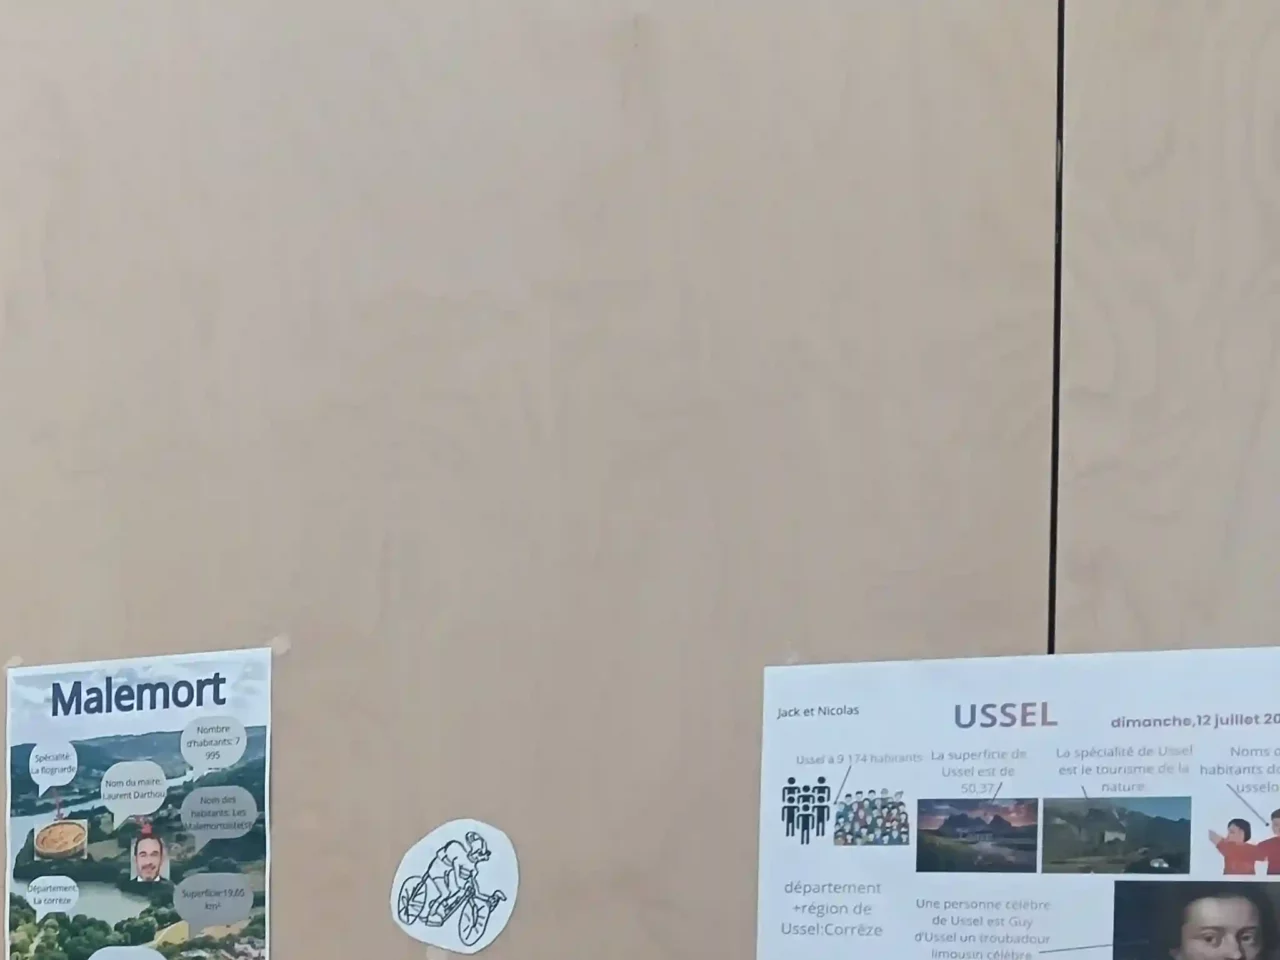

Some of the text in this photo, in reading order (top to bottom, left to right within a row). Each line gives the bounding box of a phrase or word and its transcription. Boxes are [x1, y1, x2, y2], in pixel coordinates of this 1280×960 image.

[51, 672, 227, 717] Malemort
[777, 704, 860, 720] Jack et Nicolas
[954, 701, 1058, 728] USSEL
[1213, 713, 1260, 729] juillet
[196, 725, 231, 735] Nombre
[235, 736, 240, 746] 7
[205, 750, 221, 760] 995
[931, 748, 1027, 763] La superficie de
[1056, 744, 1193, 761] La spécialité de Ussel
[1230, 746, 1270, 757] Noms
[796, 754, 825, 765] Ussel
[836, 755, 844, 765] 9
[848, 754, 867, 765] 174
[870, 752, 924, 764] habitants
[941, 766, 1015, 777] Ussel est de
[1058, 762, 1190, 776] est le tourisme de la
[1199, 764, 1263, 776] habitants
[105, 779, 124, 788] Nom
[126, 778, 136, 787] du
[1101, 781, 1145, 792] nature
[783, 880, 882, 897] département
[792, 901, 872, 918] +région de
[915, 898, 941, 909] Une
[944, 900, 1001, 911] personne
[931, 915, 1033, 930] de Ussel est Guy
[914, 931, 1051, 945] d'Ussel un troubadour
[931, 948, 983, 960] limousin
